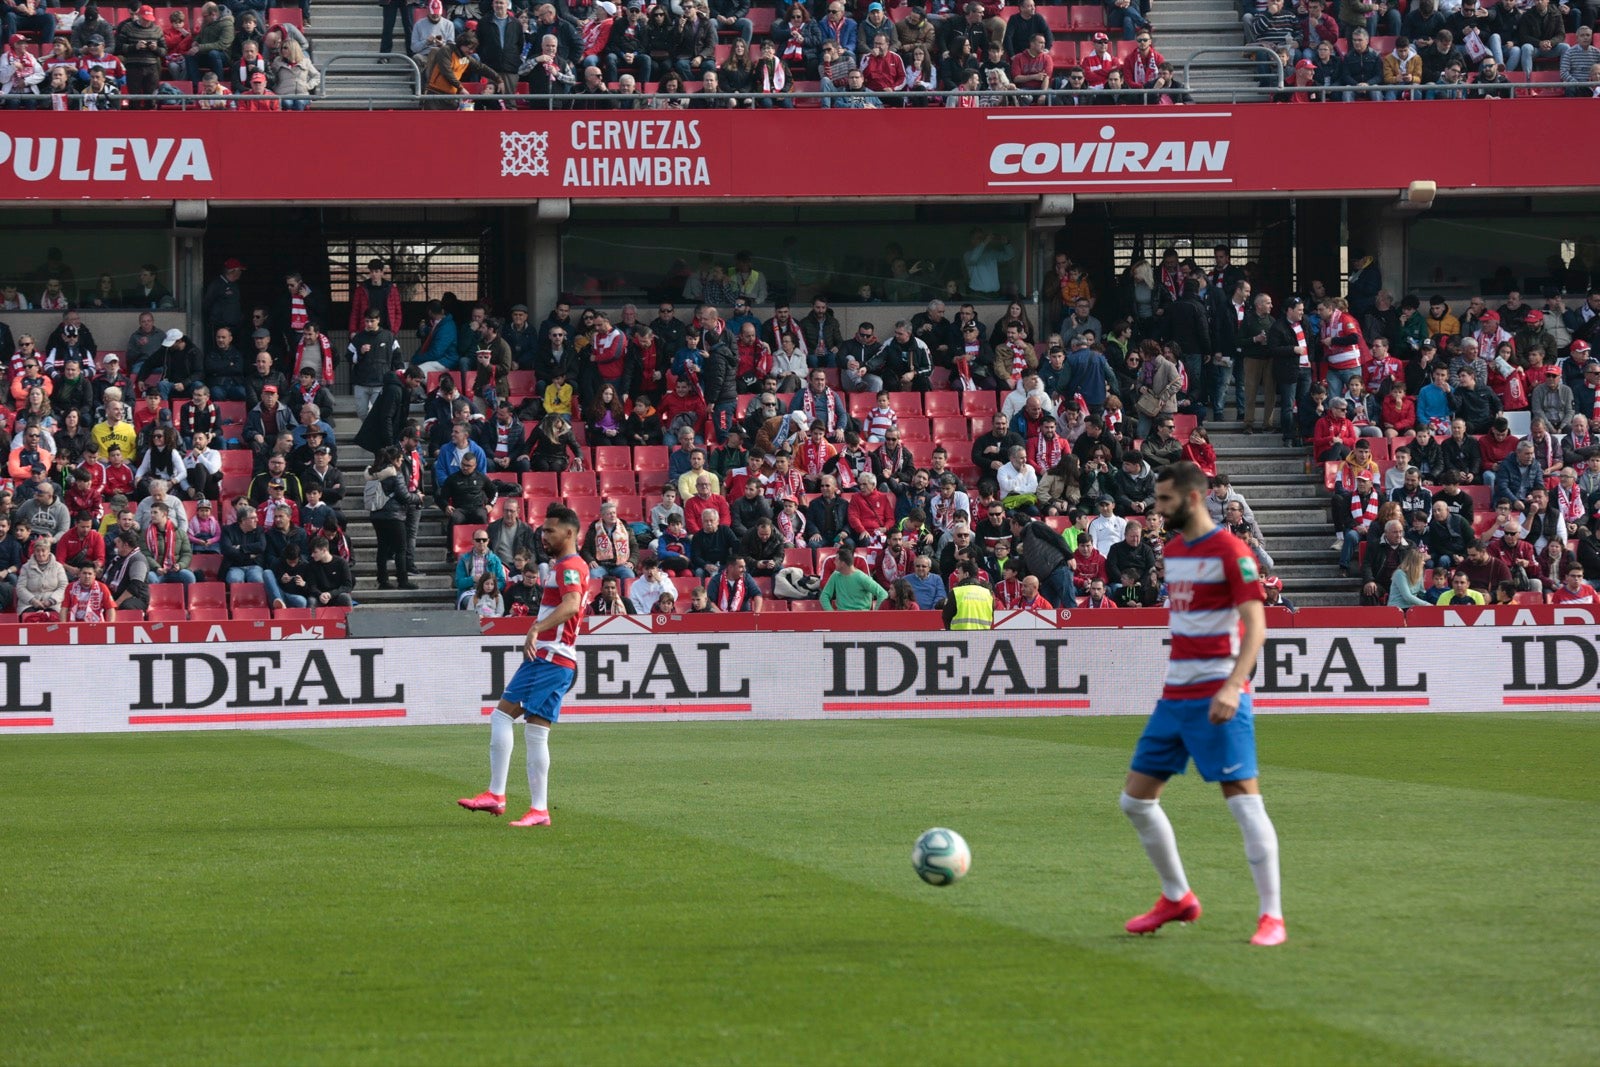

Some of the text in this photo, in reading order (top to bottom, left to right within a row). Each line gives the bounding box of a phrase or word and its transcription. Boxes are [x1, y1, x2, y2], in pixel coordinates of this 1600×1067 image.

[571, 119, 701, 150] CERVEZAS
[562, 156, 711, 187] ALHAMBRA
[129, 648, 406, 710] IDEAL
[481, 642, 750, 701] IEAL
[823, 639, 1088, 697] IDEAL
